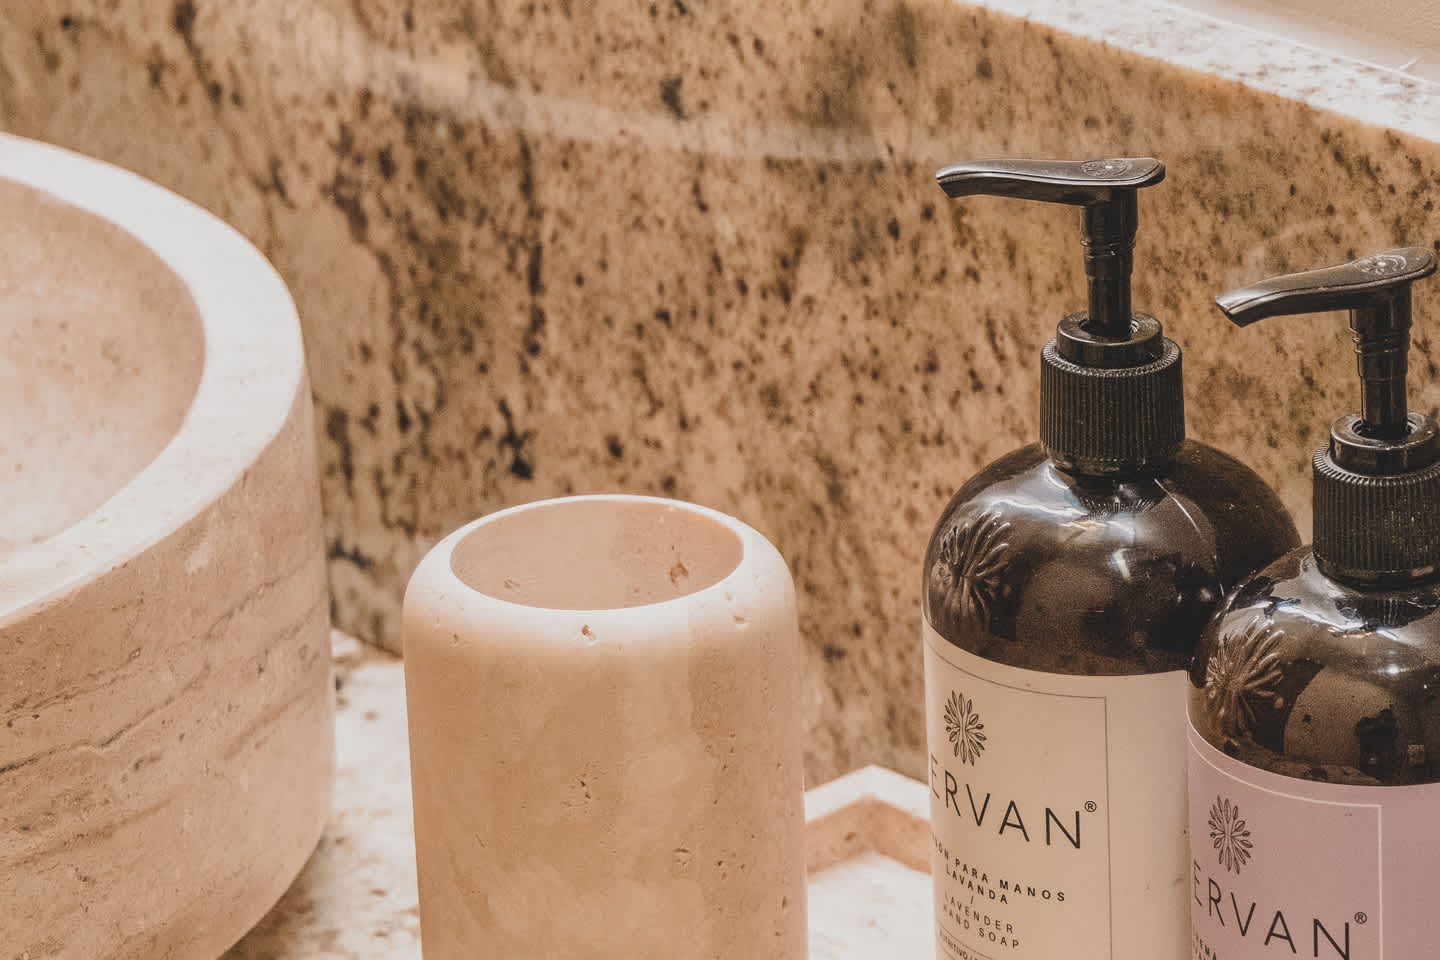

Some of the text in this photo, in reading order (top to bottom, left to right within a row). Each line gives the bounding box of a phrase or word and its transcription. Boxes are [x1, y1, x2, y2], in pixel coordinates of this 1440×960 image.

[945, 863, 1008, 905] LAVANDA
[955, 858, 1065, 902] PARA MANOS
[978, 927, 1020, 949] SOAP
